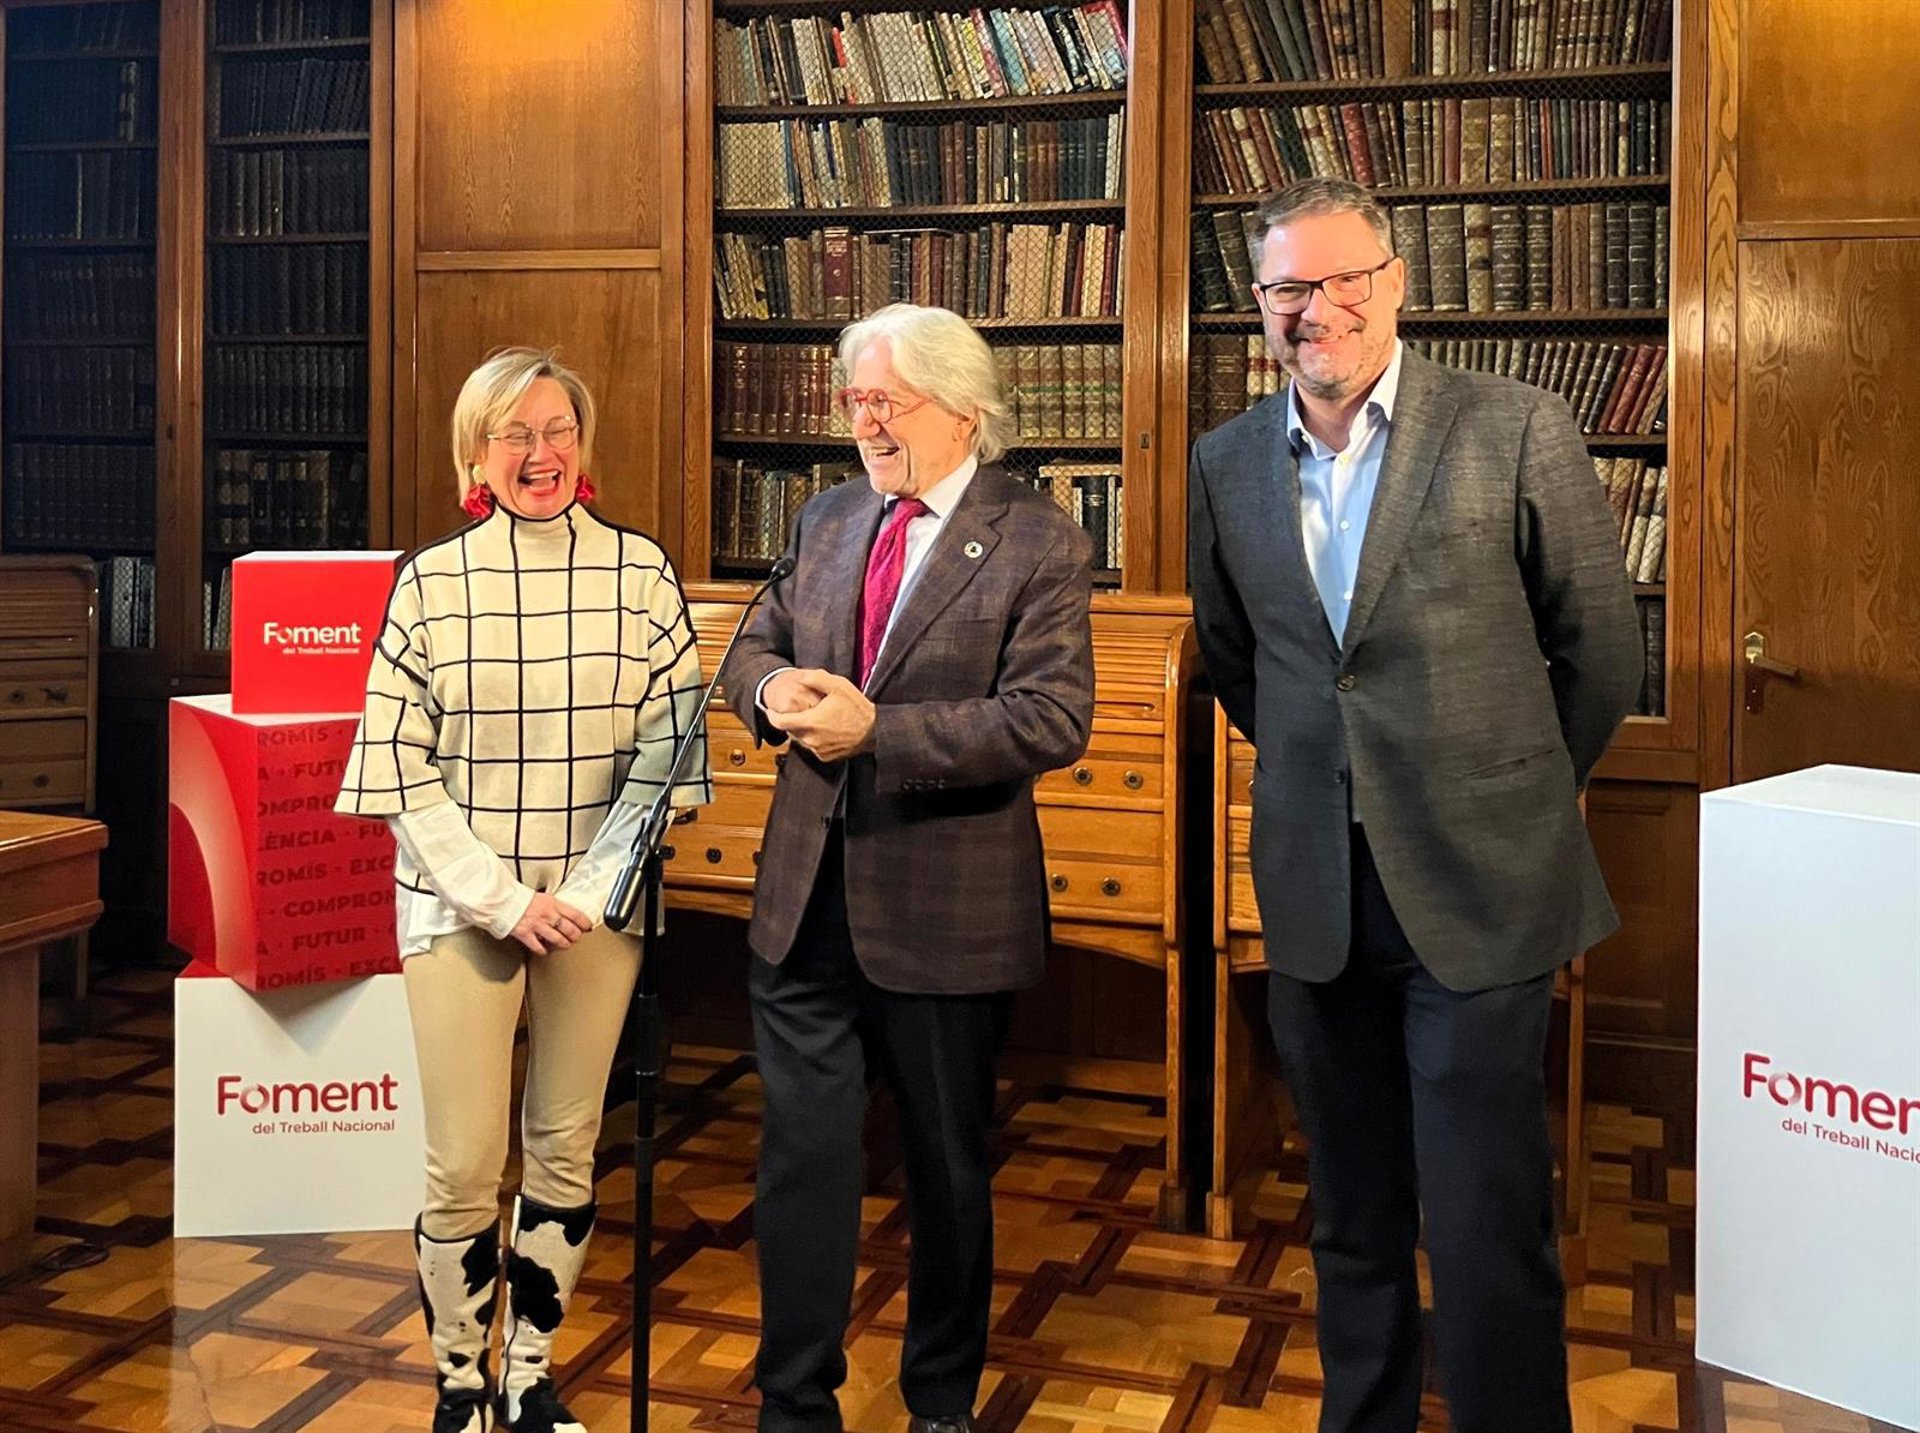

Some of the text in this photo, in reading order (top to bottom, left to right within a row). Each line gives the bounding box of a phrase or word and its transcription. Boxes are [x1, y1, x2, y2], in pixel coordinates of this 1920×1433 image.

[263, 621, 361, 645] Foment
[293, 927, 365, 950] FUTUR
[217, 1073, 399, 1115] Foment
[252, 1119, 395, 1134] del Treball Nacional
[1782, 1117, 1807, 1135] del
[1812, 1123, 1869, 1151] Treball
